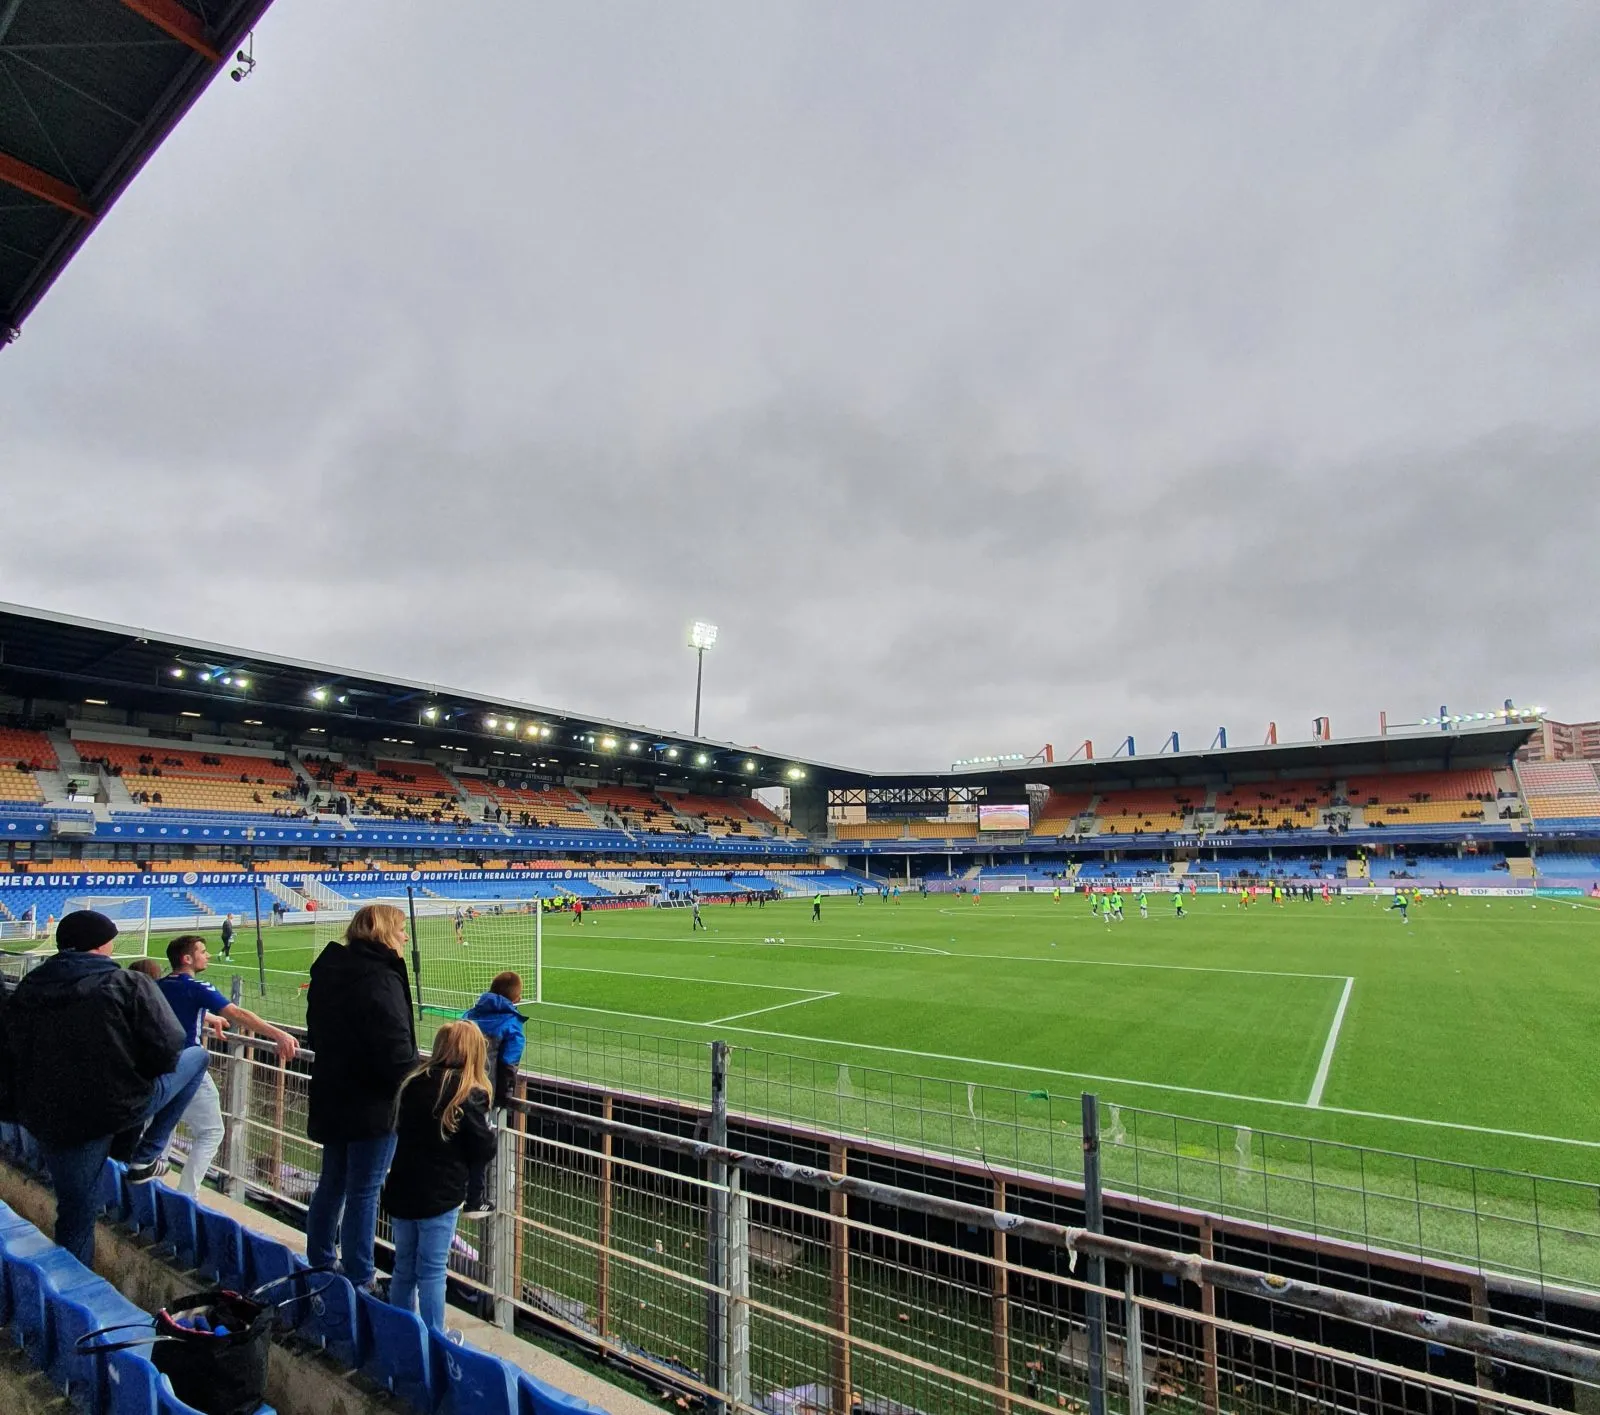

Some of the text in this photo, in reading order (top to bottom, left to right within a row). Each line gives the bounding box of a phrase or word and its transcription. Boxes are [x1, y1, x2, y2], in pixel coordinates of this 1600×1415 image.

[293, 872, 344, 883] HERAULT
[347, 872, 380, 882] SPORT
[383, 872, 408, 881] CLUB
[423, 869, 563, 881] MONTPELLIER HERAULT SPORT CLUB
[643, 870, 660, 878] SPORT
[0, 874, 178, 887] HERAULT SPORT CLUB
